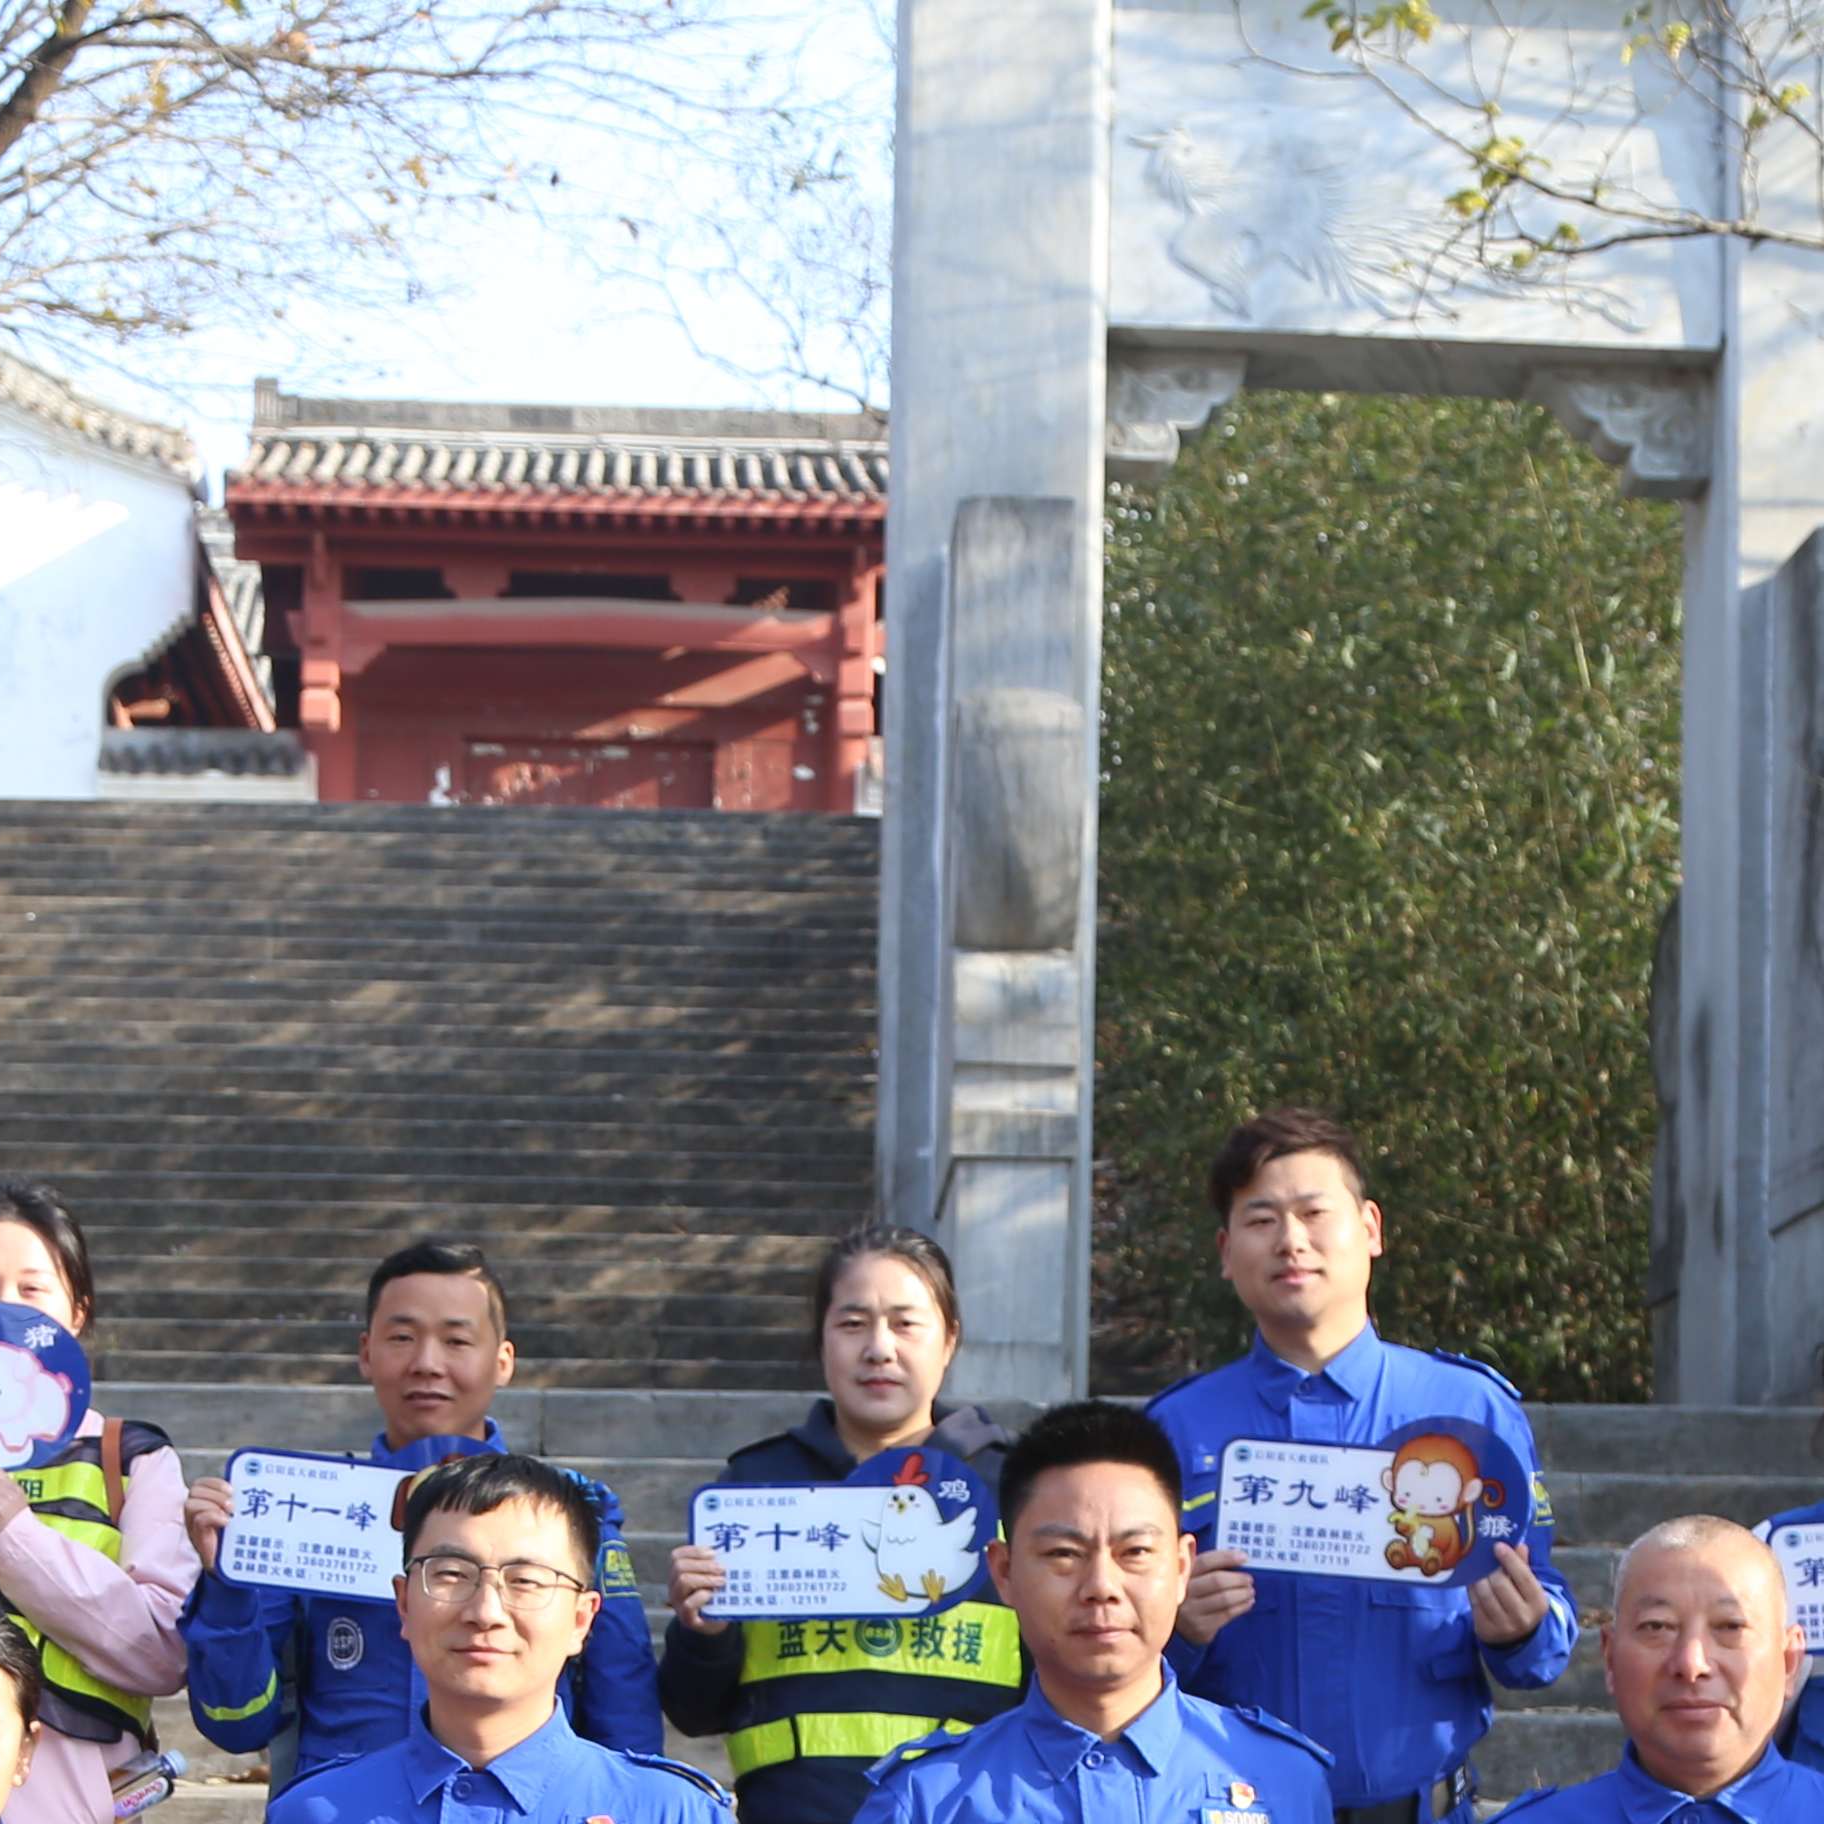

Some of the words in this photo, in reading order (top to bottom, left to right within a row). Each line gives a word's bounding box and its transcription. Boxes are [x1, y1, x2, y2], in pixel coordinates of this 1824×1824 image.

[24, 1324, 58, 1350] 猪
[937, 1480, 971, 1502] 鸡
[1233, 1473, 1379, 1514] 第九峰
[240, 1486, 378, 1532] 第十一峰
[705, 1521, 851, 1552] 第十峰
[1478, 1514, 1510, 1538] 猴
